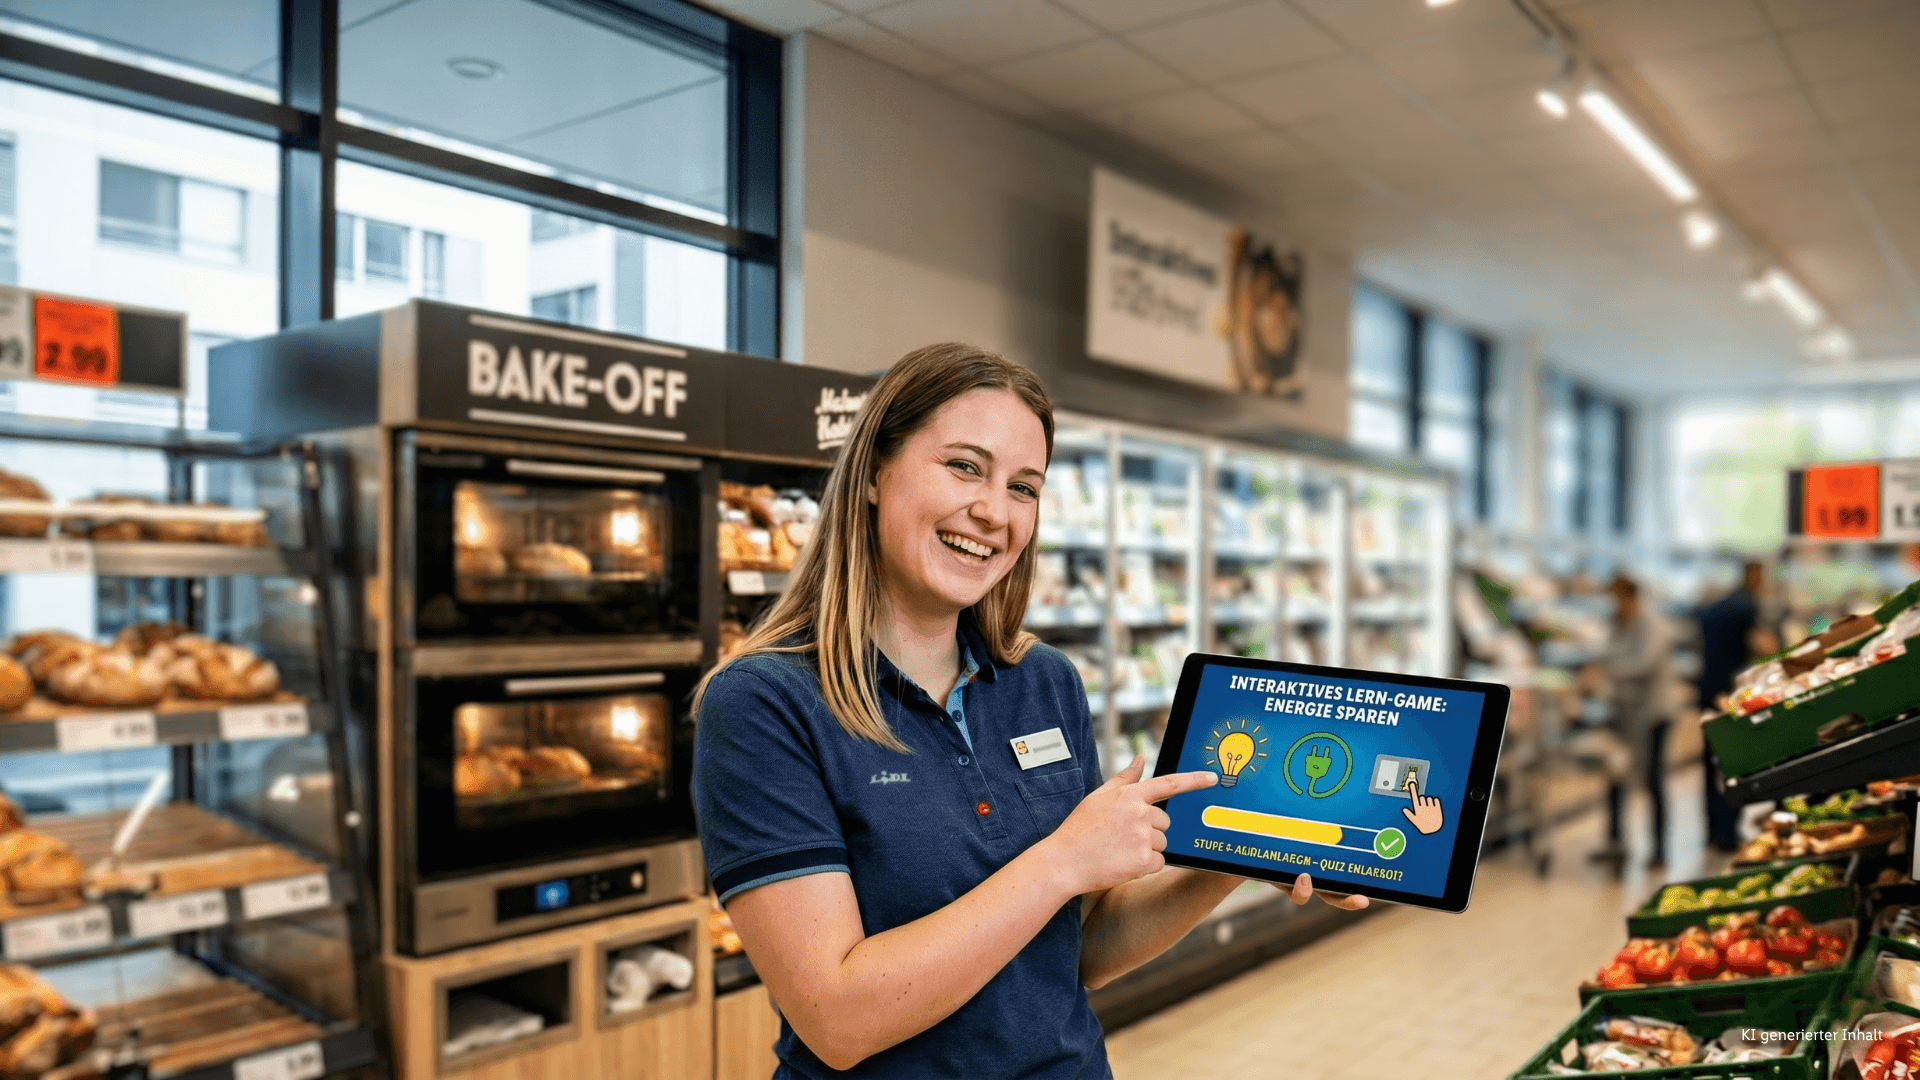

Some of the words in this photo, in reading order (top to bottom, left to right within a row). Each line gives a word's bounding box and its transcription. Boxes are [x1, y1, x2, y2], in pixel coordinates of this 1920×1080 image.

[468, 339, 688, 418] BAKE-OFF
[1229, 675, 1343, 701] INTERAKTIVES
[1346, 687, 1447, 713] LERN-GAME:
[1264, 697, 1332, 719] ENERGIE
[1334, 704, 1400, 727] SPAREN
[1319, 858, 1346, 872] QUIZ
